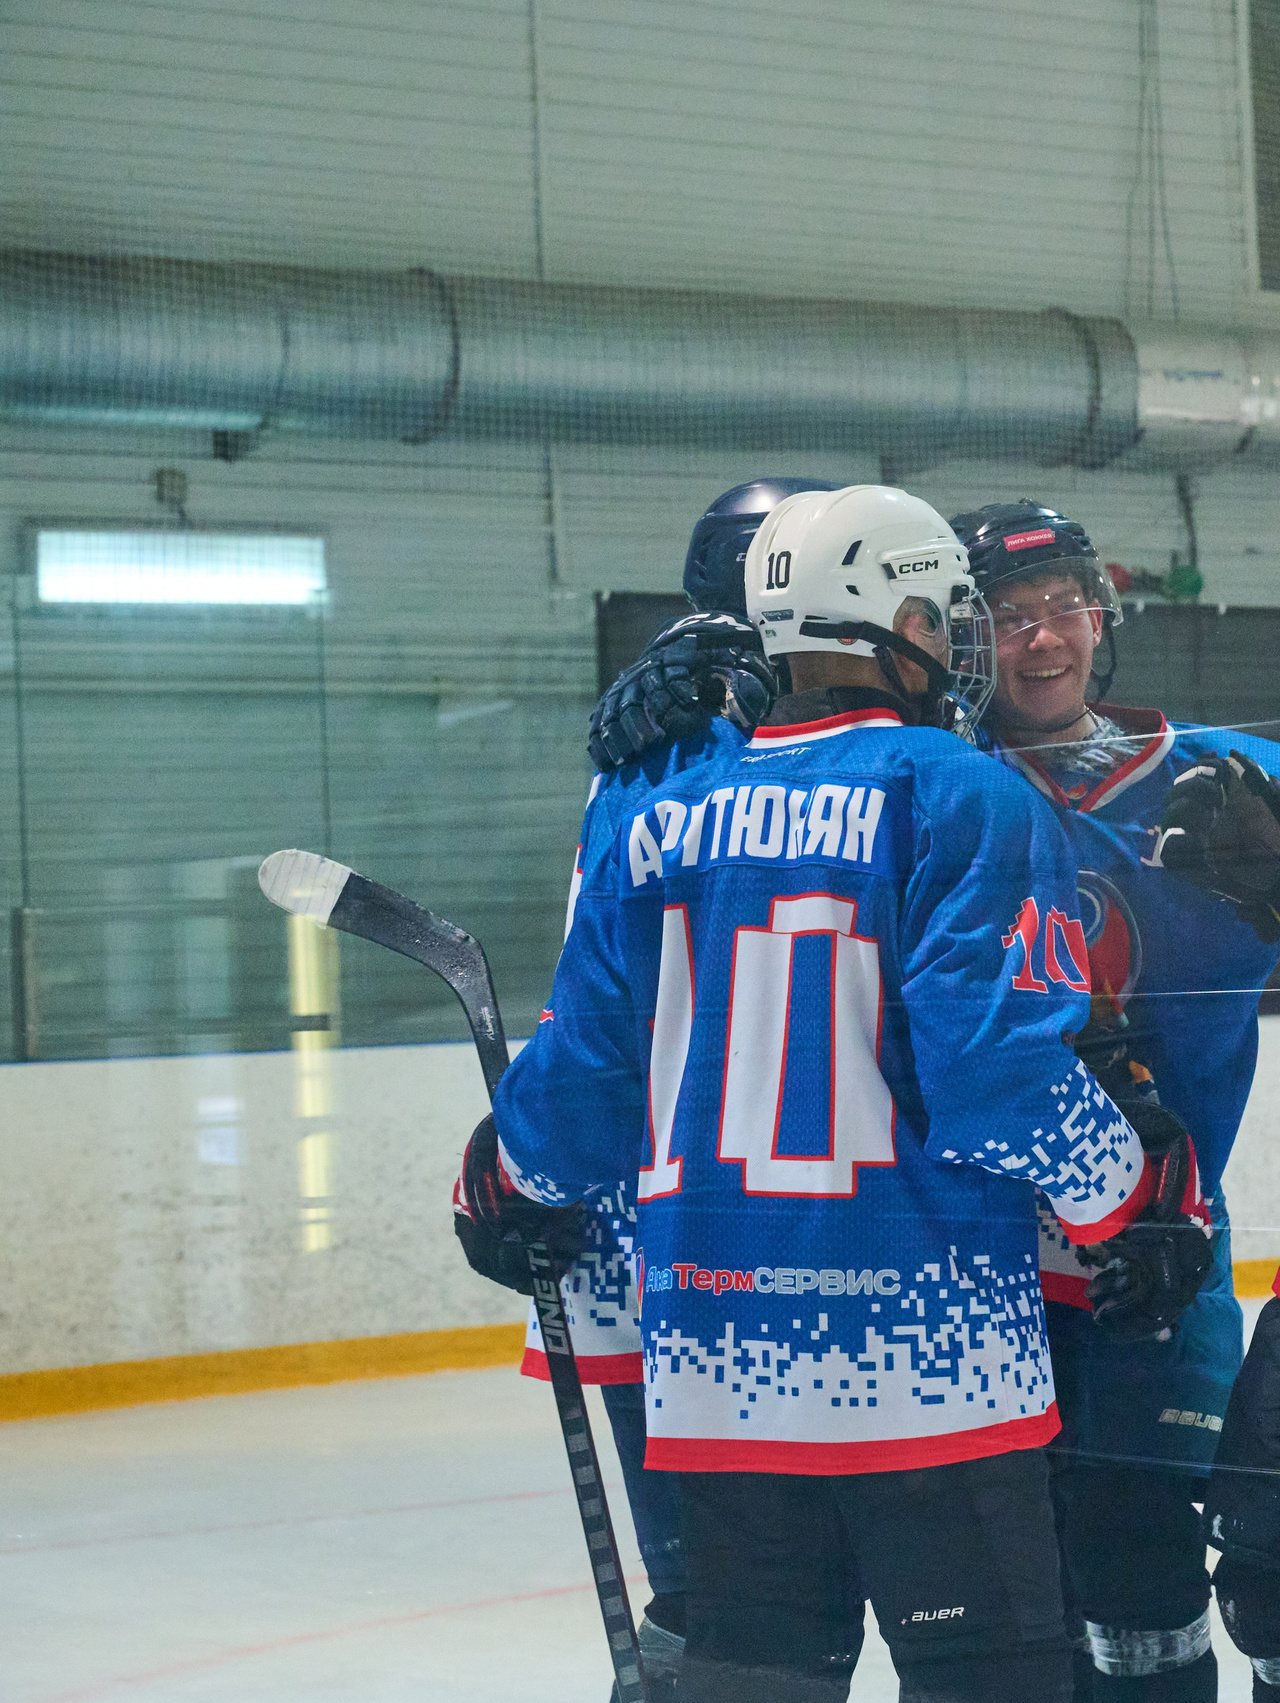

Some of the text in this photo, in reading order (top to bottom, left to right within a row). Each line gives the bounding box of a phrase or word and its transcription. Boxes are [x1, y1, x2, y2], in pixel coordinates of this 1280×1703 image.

[766, 550, 792, 590] 10
[898, 559, 939, 574] CCM
[628, 783, 887, 888] АРУТЮНЯН
[1001, 896, 1092, 994] 10
[637, 891, 898, 1204] 10
[1159, 1408, 1225, 1433] BAUE
[911, 1606, 965, 1622] AUER
